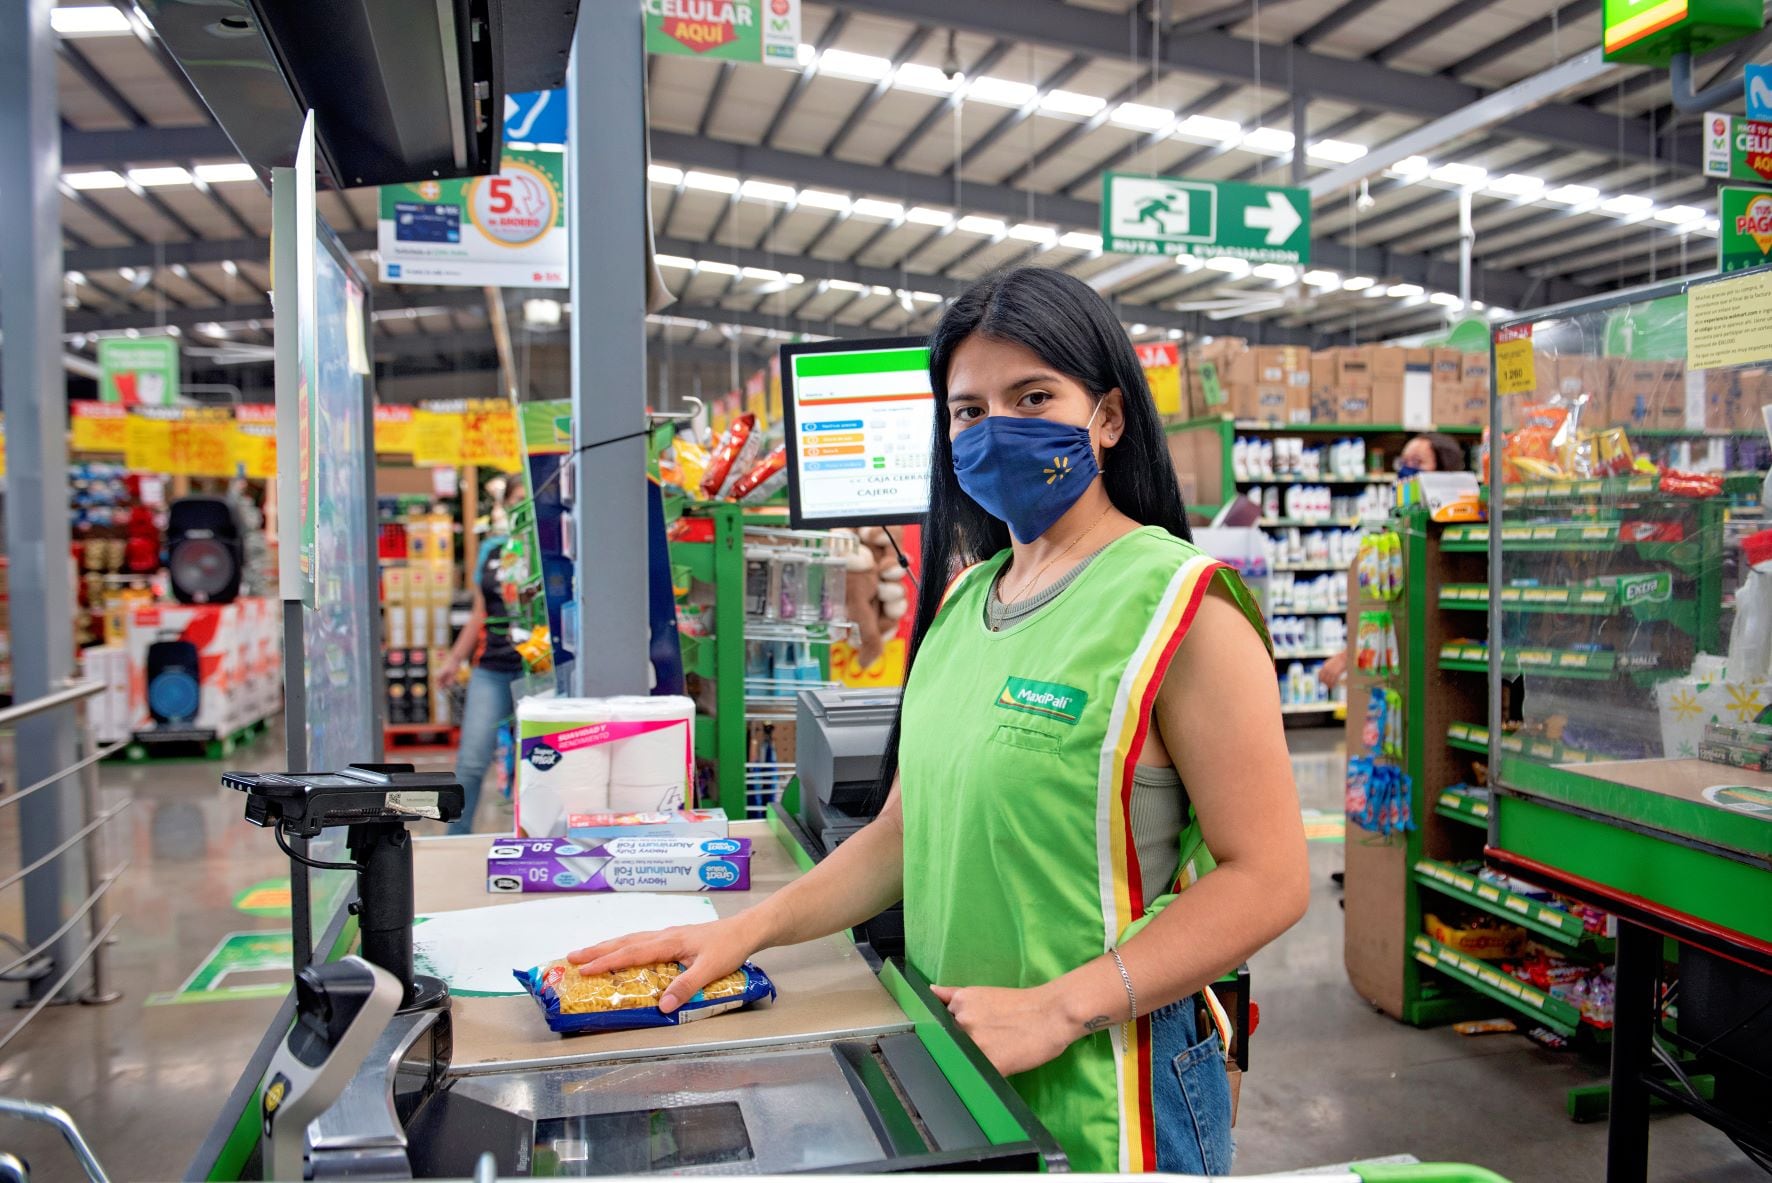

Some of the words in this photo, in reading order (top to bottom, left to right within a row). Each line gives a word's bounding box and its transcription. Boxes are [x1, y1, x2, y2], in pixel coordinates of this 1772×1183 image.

[648, 0, 753, 26] CELULAR
[675, 22, 724, 43] AQUÍ
[1112, 239, 1159, 254] RUTA
[1164, 244, 1188, 256] DE
[857, 488, 898, 497] CAJERO
[1626, 578, 1658, 600] Extra
[558, 725, 599, 741] SUAVIDAD
[599, 724, 608, 732] Y
[558, 732, 610, 749] RENDIMIENTO
[532, 842, 553, 852] 50
[616, 841, 635, 849] Foil
[529, 867, 549, 881] 50
[614, 866, 632, 876] Foil
[635, 866, 692, 876] Aluminum
[705, 871, 736, 881] Great
[614, 876, 635, 886] Duty
[638, 877, 667, 886] Heavy
